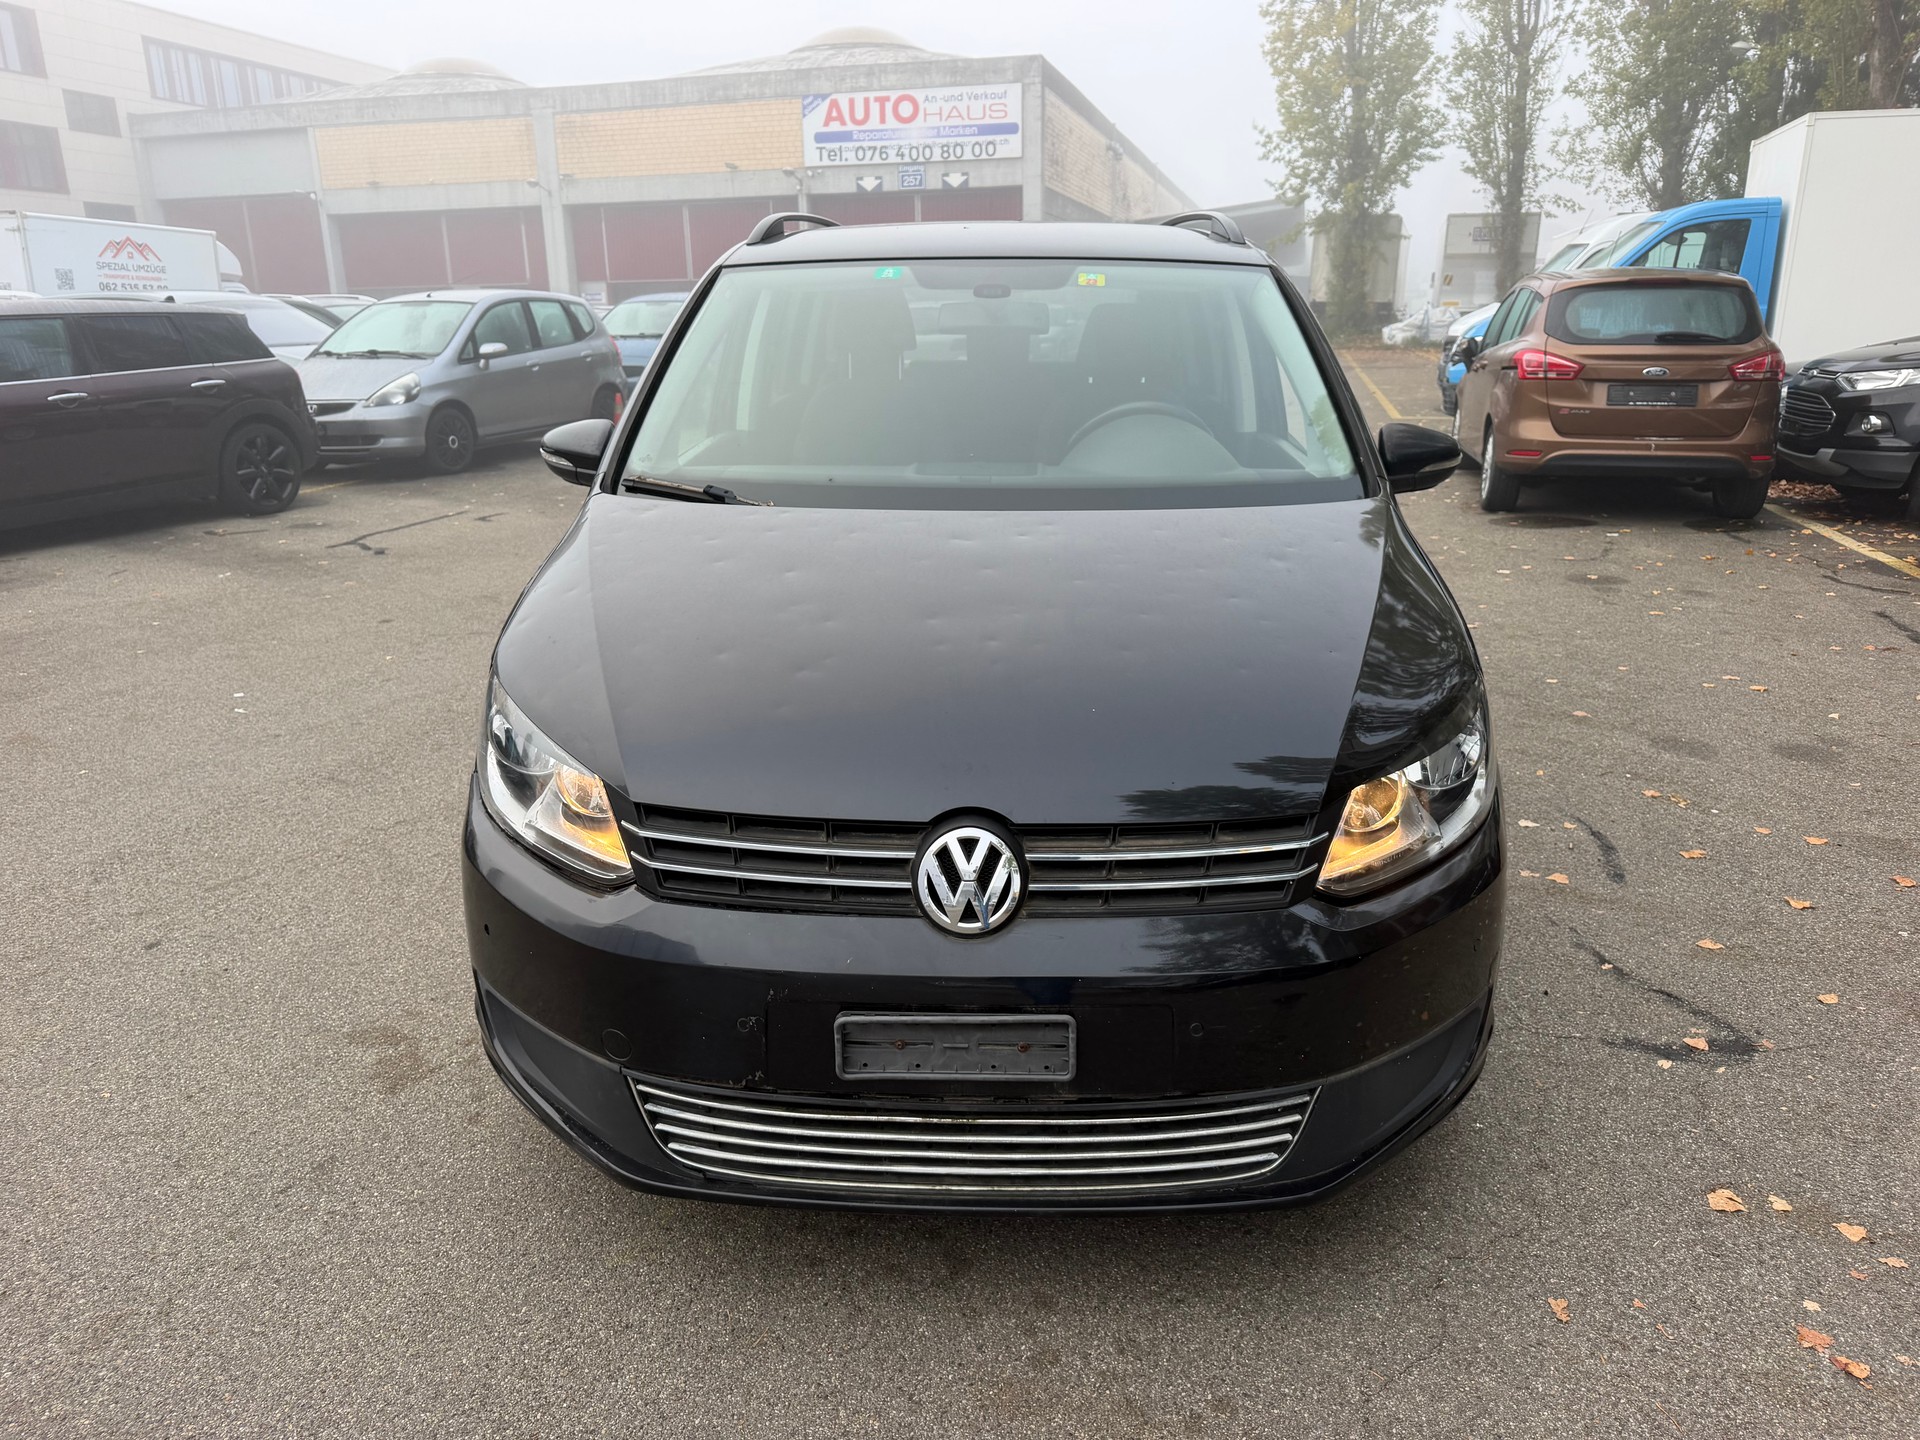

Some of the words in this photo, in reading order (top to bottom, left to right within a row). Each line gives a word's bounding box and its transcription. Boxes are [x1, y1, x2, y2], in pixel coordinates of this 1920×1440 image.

[966, 89, 1008, 101] Verkauf
[822, 94, 920, 128] AUTO
[923, 103, 1009, 122] HAUS
[940, 125, 978, 137] Marken
[816, 145, 849, 162] Tel.
[855, 144, 889, 161] 076
[895, 143, 934, 161] 400
[941, 143, 965, 160] 80
[971, 140, 997, 158] 00
[96, 261, 131, 272] SPEZIAL
[132, 263, 167, 274] UMZÜGE
[98, 281, 118, 291] 062
